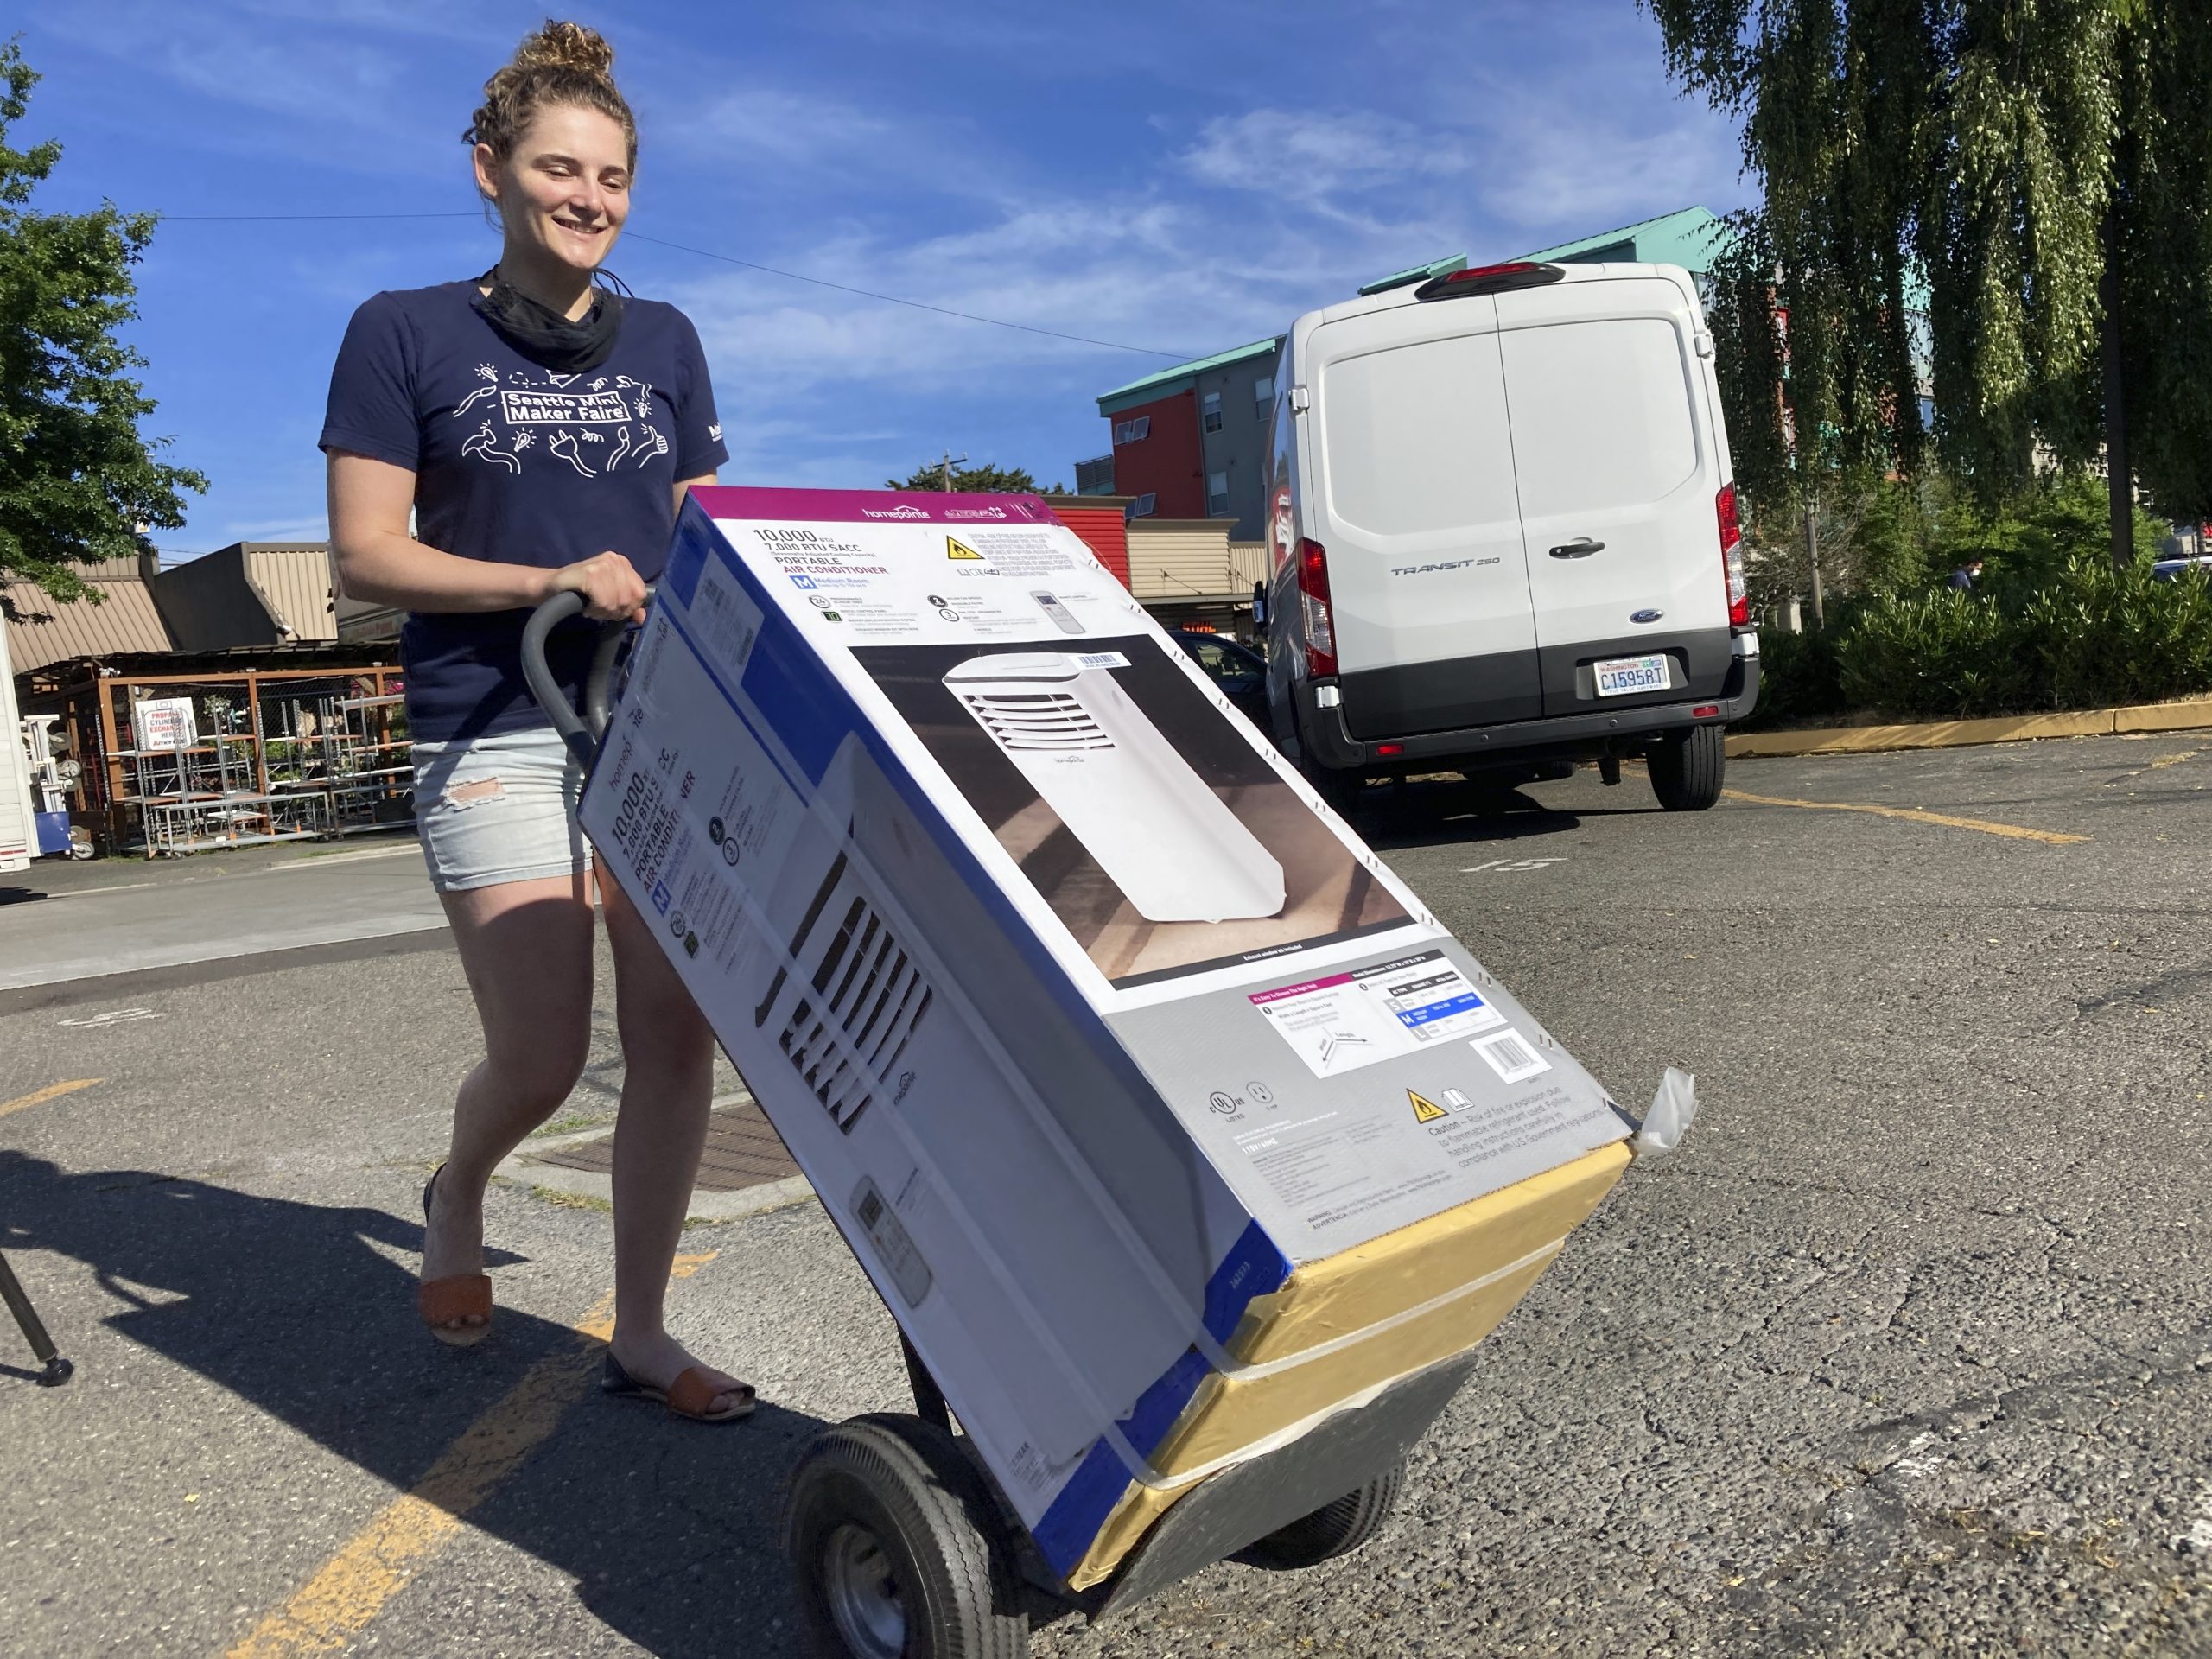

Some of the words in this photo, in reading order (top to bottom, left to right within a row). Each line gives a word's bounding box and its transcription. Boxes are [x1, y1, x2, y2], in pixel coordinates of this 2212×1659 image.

[508, 394, 575, 407] Seattle
[579, 395, 619, 407] Mini
[511, 405, 572, 421] Maker
[578, 405, 623, 421] Faire
[862, 507, 931, 519] homepointe
[753, 529, 817, 543] 10,000
[808, 566, 889, 574] CONDITIONER
[1391, 559, 1474, 576] TRANSIT
[1476, 557, 1500, 566] 250
[798, 577, 813, 588] M
[1600, 663, 1639, 672] WASHINGTON
[1601, 667, 1662, 690] C15958T
[611, 772, 645, 846] 10,000
[623, 818, 643, 860] 7,000
[639, 788, 654, 820] BTU
[635, 805, 669, 881] PORTABLE
[643, 868, 658, 893] AIR
[654, 887, 669, 910] M
[1390, 1002, 1400, 1011] S
[1401, 1015, 1414, 1024] M
[1415, 1030, 1425, 1038] L
[1235, 1097, 1245, 1106] US
[1225, 1113, 1245, 1123] LISTED
[1429, 1120, 1461, 1136] Caution
[1466, 1112, 1484, 1125] Risk
[1484, 1110, 1492, 1119] of
[1491, 1106, 1506, 1116] fire
[1513, 1092, 1546, 1109] explosion
[1546, 1086, 1562, 1096] due
[1438, 1137, 1449, 1147] to
[1447, 1124, 1489, 1145] flammable
[1488, 1111, 1526, 1131] refrigerant
[1545, 1096, 1571, 1109] Follow
[1447, 1139, 1484, 1157] handling
[1482, 1125, 1526, 1143] instructions
[1524, 1114, 1555, 1130] carefully
[1554, 1112, 1564, 1120] in
[1458, 1147, 1501, 1168] compliance
[1499, 1142, 1513, 1154] with
[1526, 1124, 1567, 1142] Government
